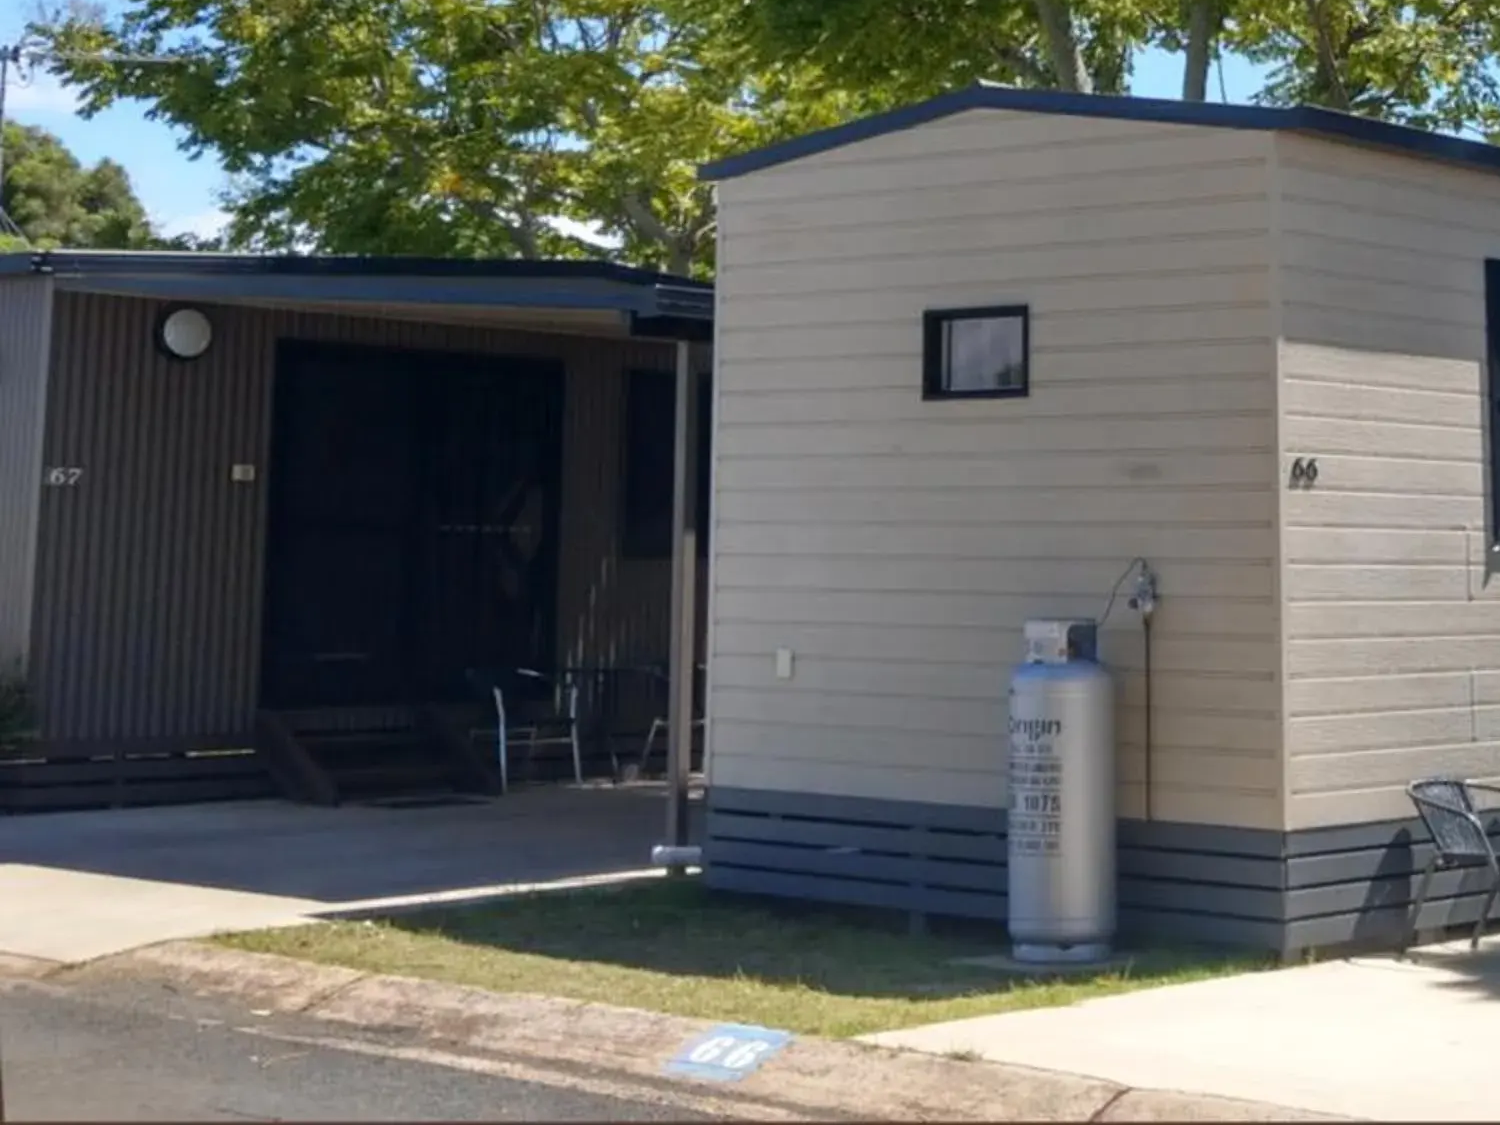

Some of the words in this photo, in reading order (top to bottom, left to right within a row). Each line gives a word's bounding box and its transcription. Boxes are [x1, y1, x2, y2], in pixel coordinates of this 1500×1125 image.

[50, 467, 83, 486] 67
[1291, 457, 1318, 482] 66
[689, 1036, 769, 1069] 66
